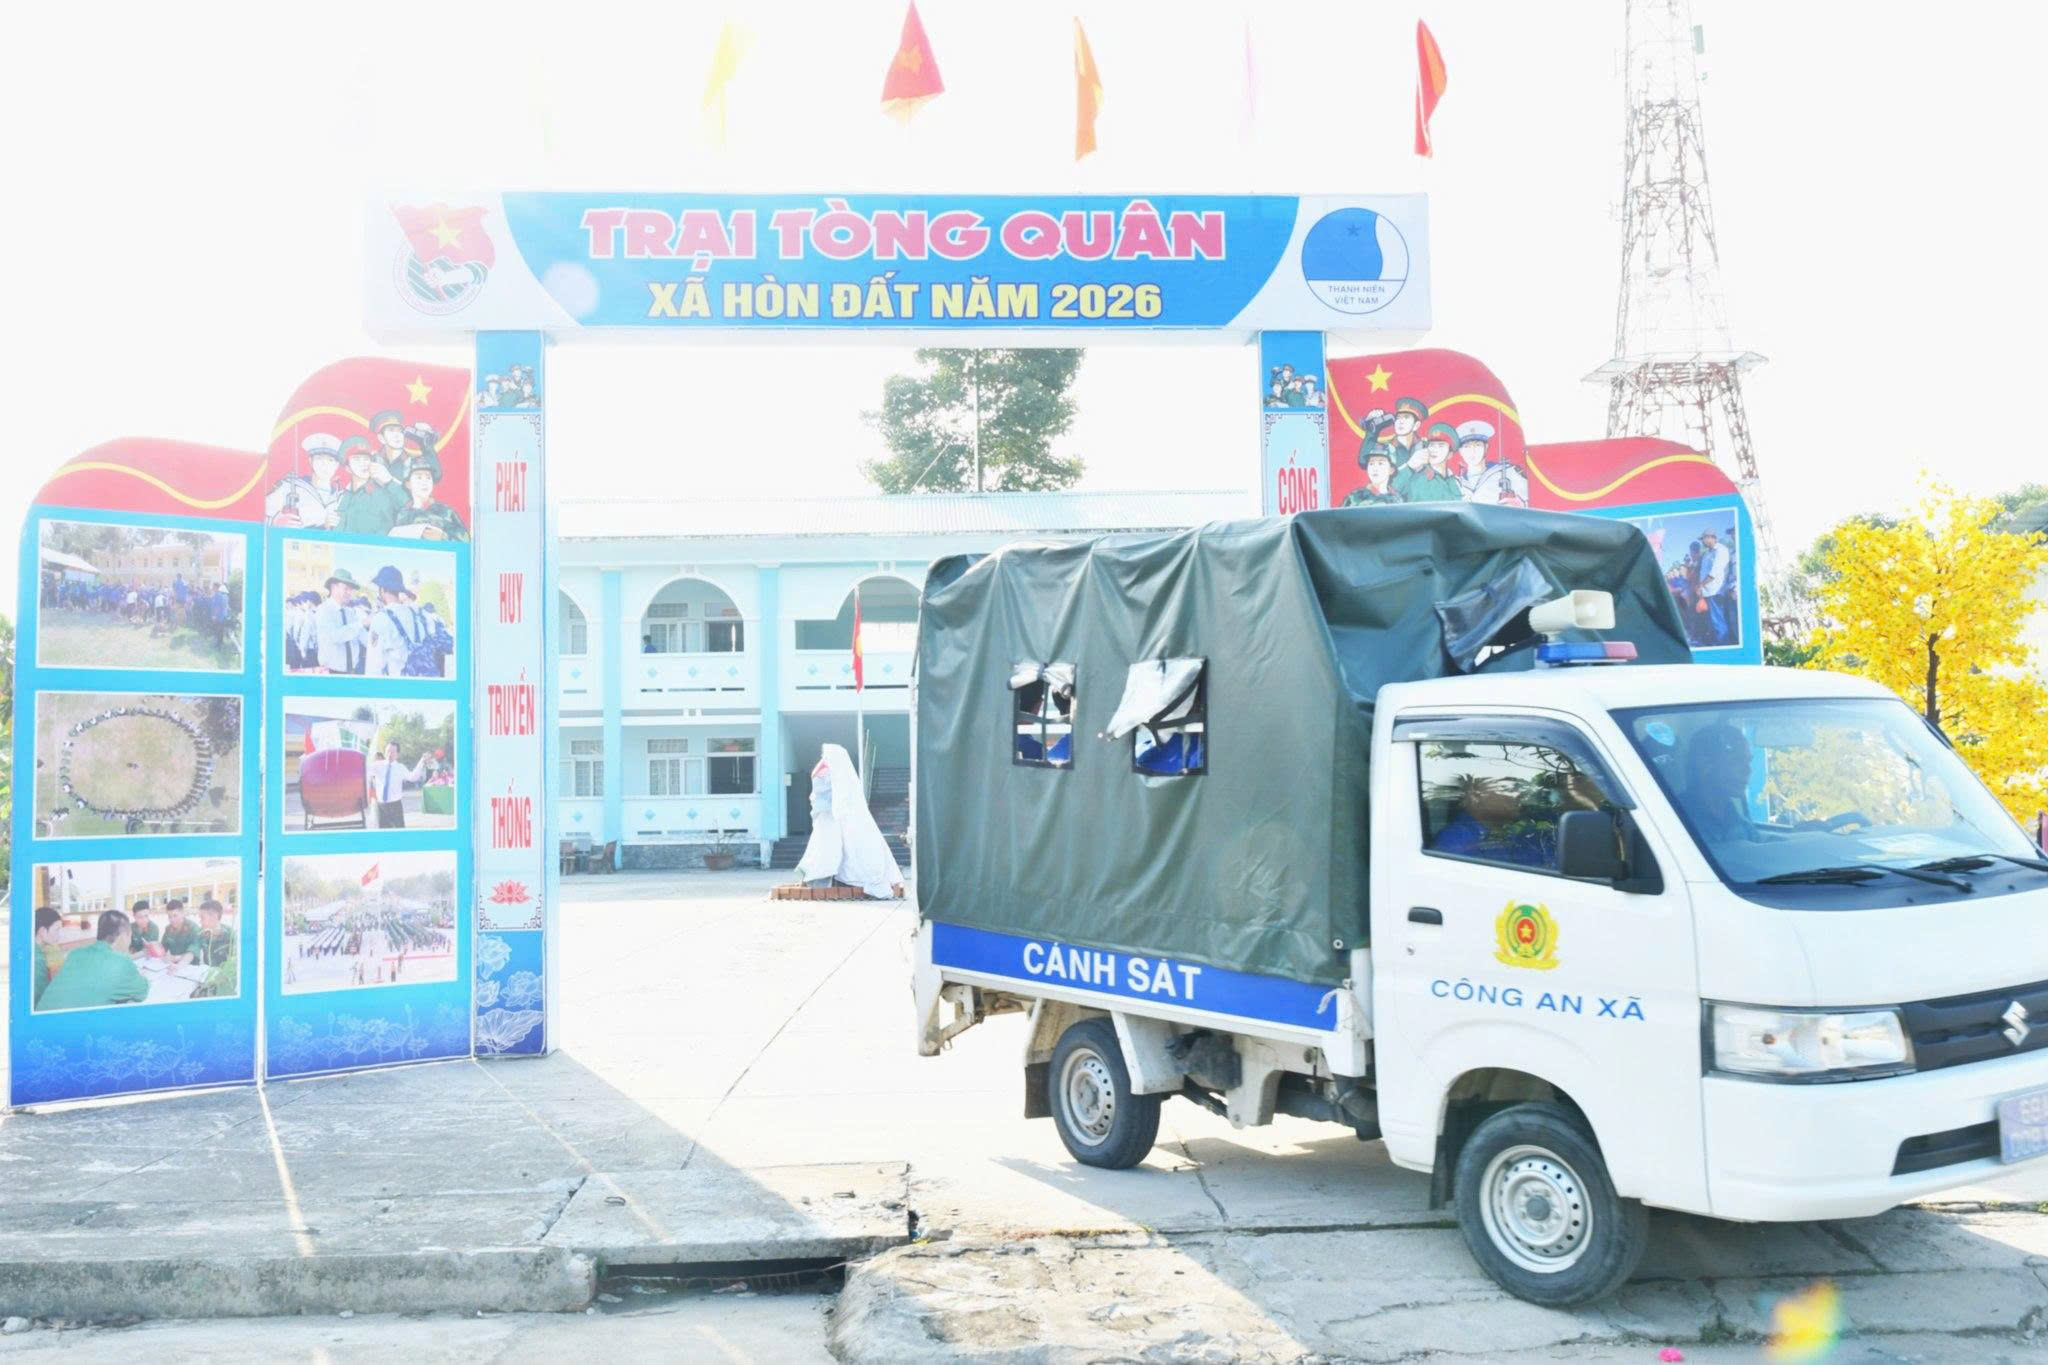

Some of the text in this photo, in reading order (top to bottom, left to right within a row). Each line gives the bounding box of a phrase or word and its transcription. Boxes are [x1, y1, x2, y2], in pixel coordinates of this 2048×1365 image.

[580, 198, 1225, 271] TRẠI TÒNG QUÂN
[646, 270, 1162, 320] XÃ HÒN ĐẤT NĂM 2026
[1328, 285, 1360, 293] THANH
[1358, 297, 1379, 305] NAM
[496, 450, 527, 512] PHÁT
[1278, 448, 1318, 515] CỐNG
[499, 573, 524, 624] HUY
[488, 667, 535, 735] TRUYỀN
[490, 778, 532, 848] THỐNG
[1127, 957, 1202, 1000] SÁT
[1431, 977, 1646, 1021] CÔNG AN XÃ
